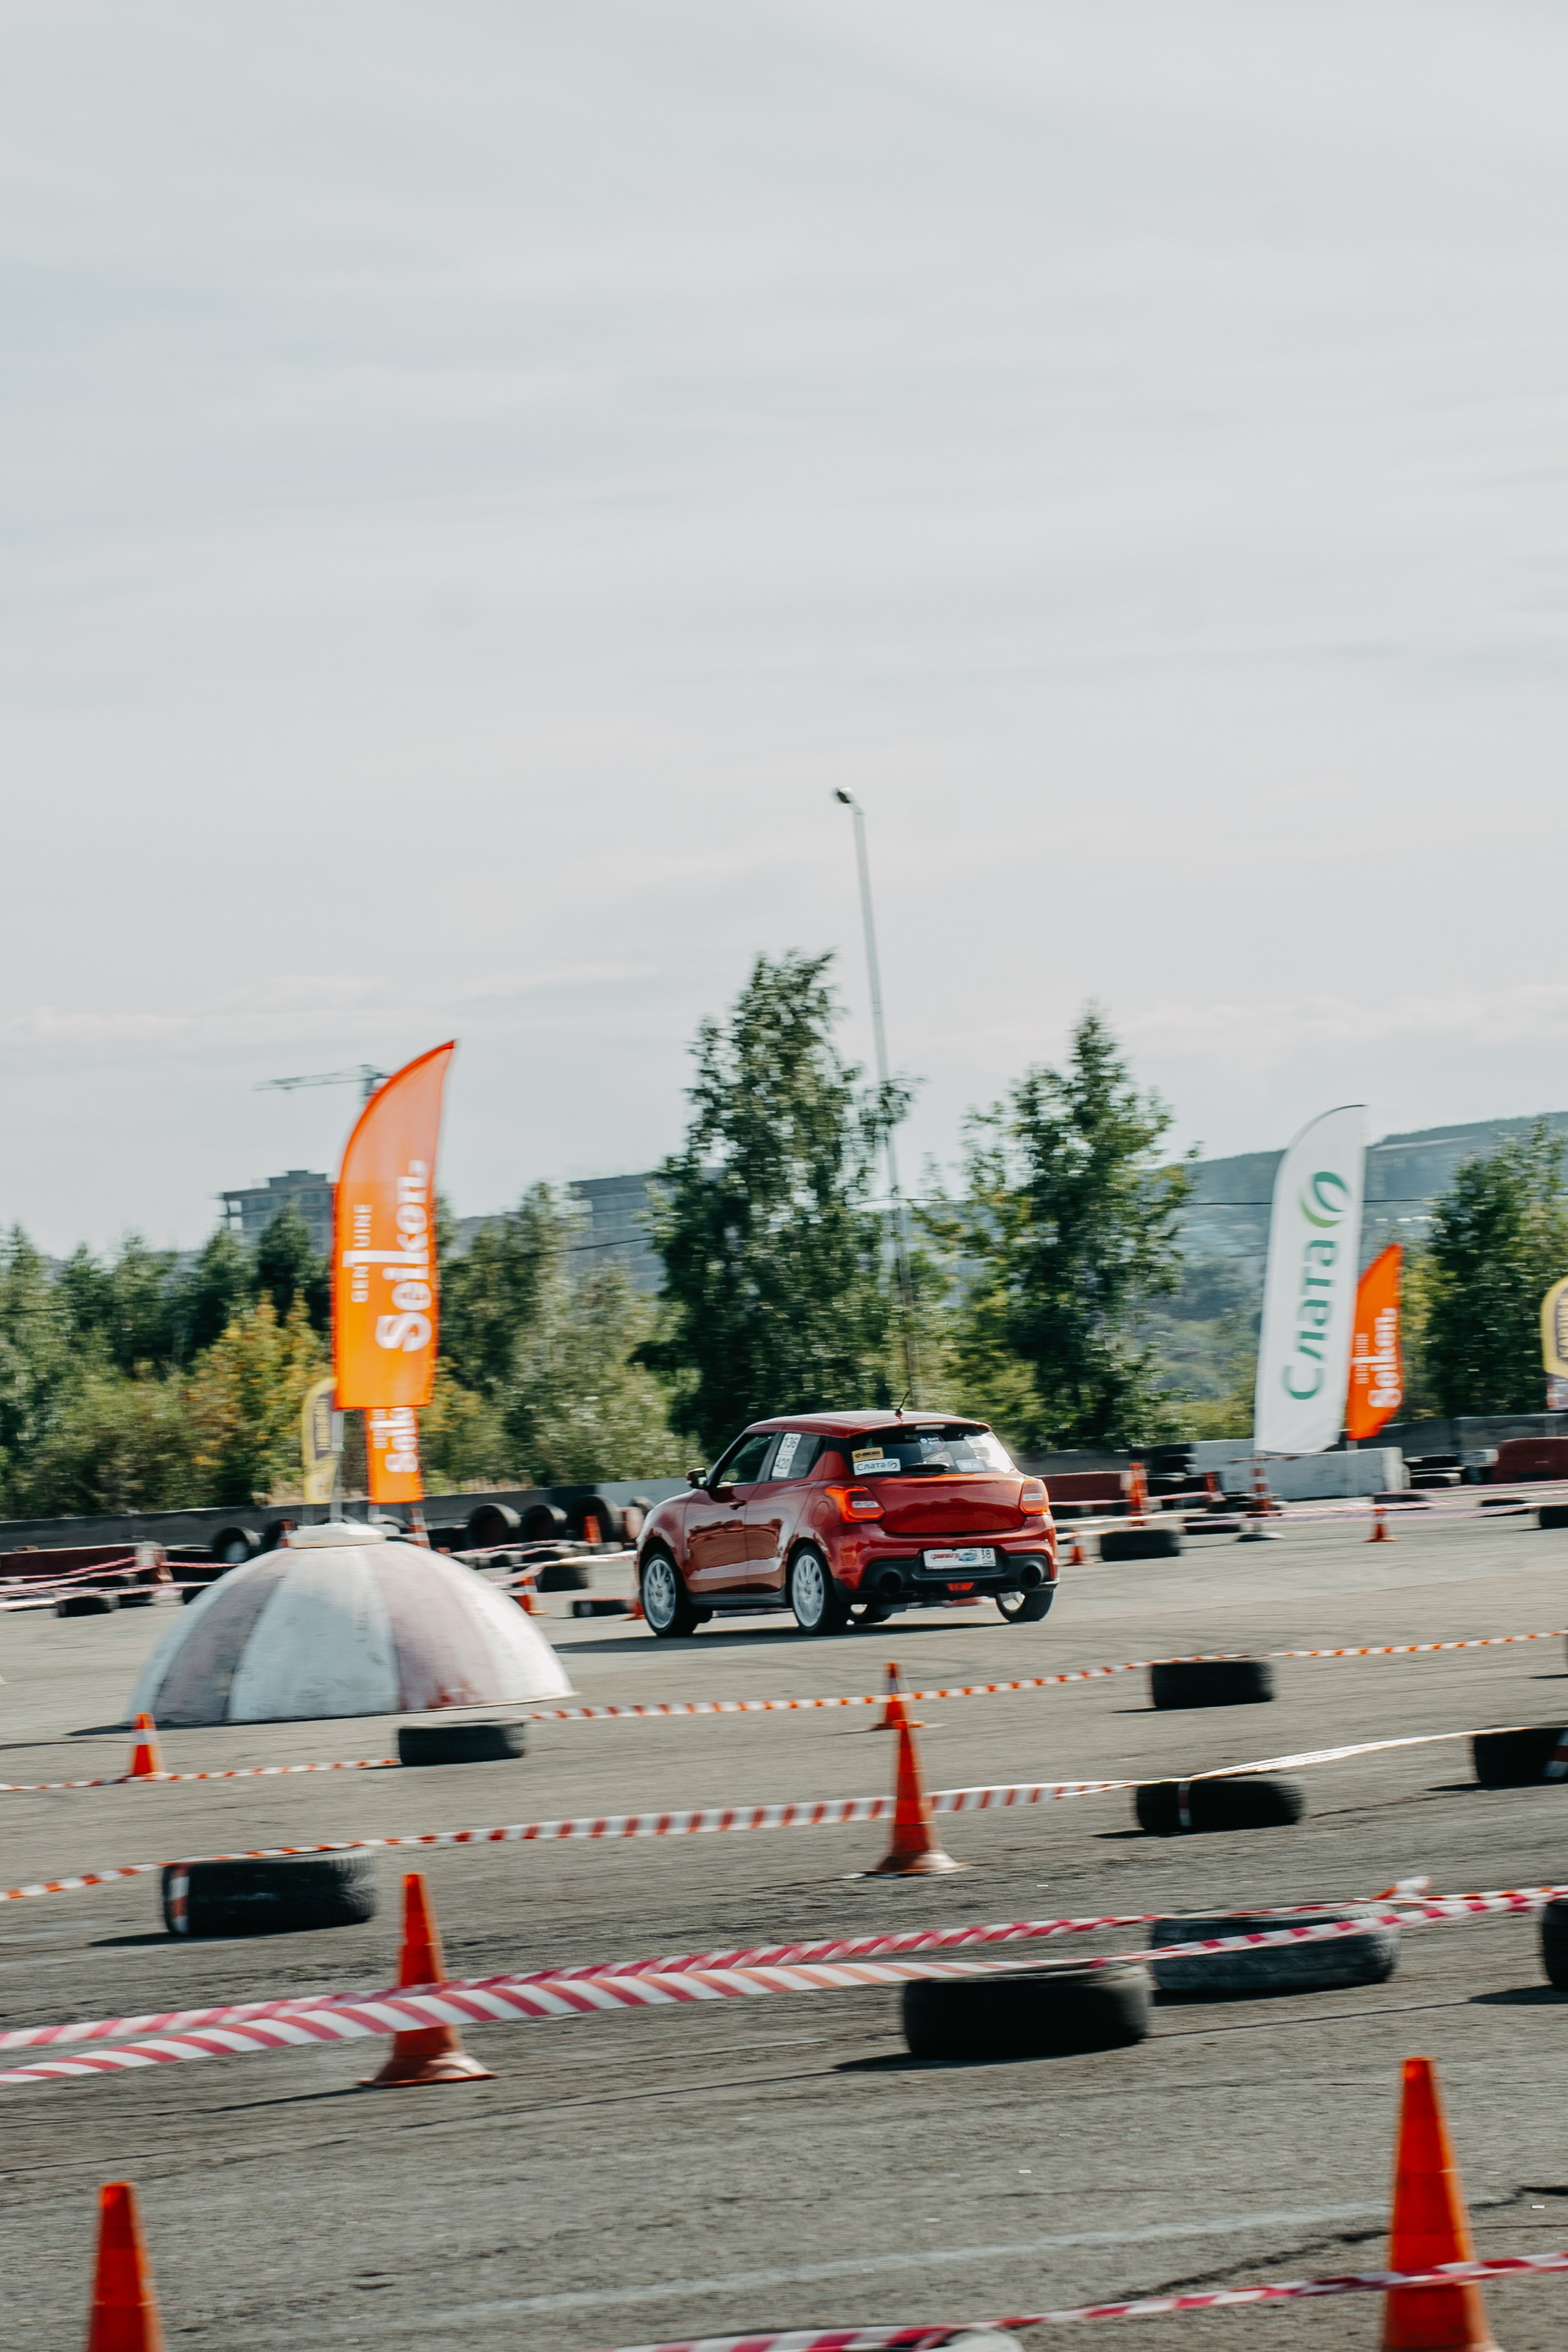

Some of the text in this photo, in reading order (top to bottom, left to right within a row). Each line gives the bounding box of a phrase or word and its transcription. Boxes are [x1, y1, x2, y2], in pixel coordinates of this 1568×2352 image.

[1280, 1239, 1339, 1401] Слата
[369, 1407, 419, 1473] Seik
[775, 1457, 790, 1469] 420
[856, 1462, 886, 1471] Слата
